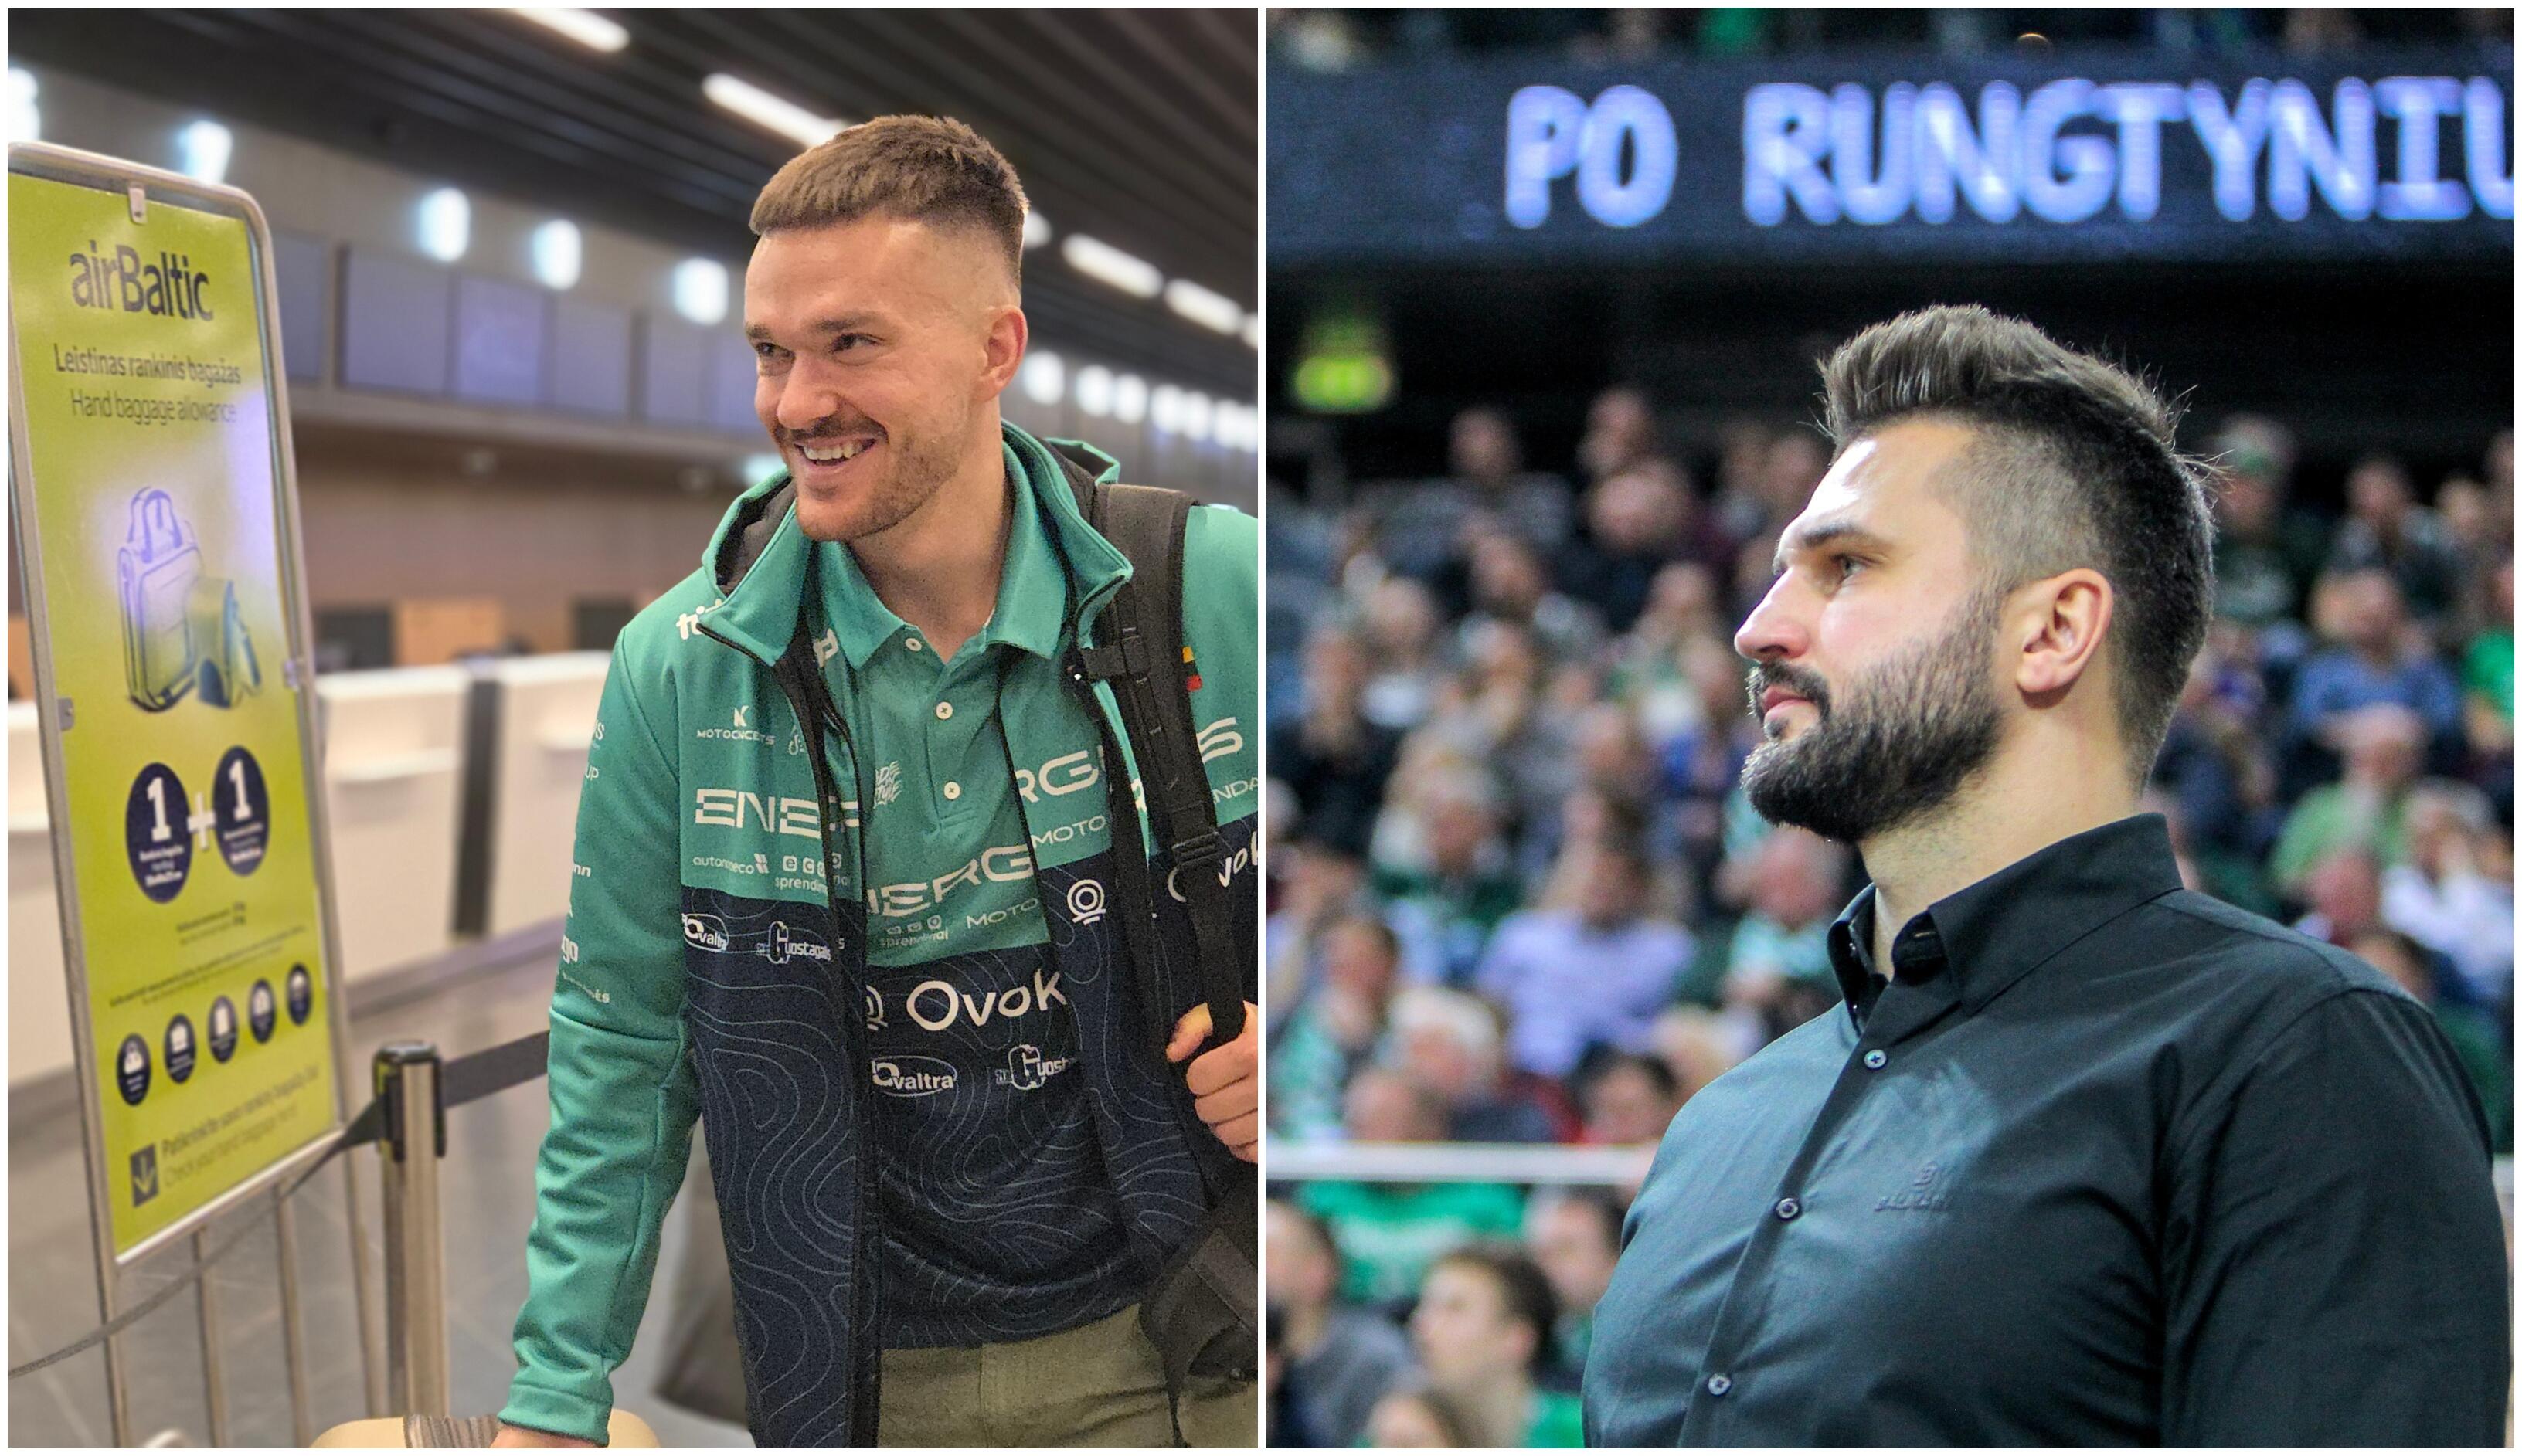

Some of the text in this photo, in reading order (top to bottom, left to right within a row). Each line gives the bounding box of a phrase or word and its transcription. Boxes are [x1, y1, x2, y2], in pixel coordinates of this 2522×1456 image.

[1505, 83, 1678, 229] PO
[70, 239, 214, 321] airBaltic
[53, 343, 126, 376] Leistinas
[128, 352, 186, 381] rankinis
[71, 388, 237, 426] Hand baggage allowance
[1033, 815, 1106, 847] MOTO
[966, 898, 1038, 929] MOTO
